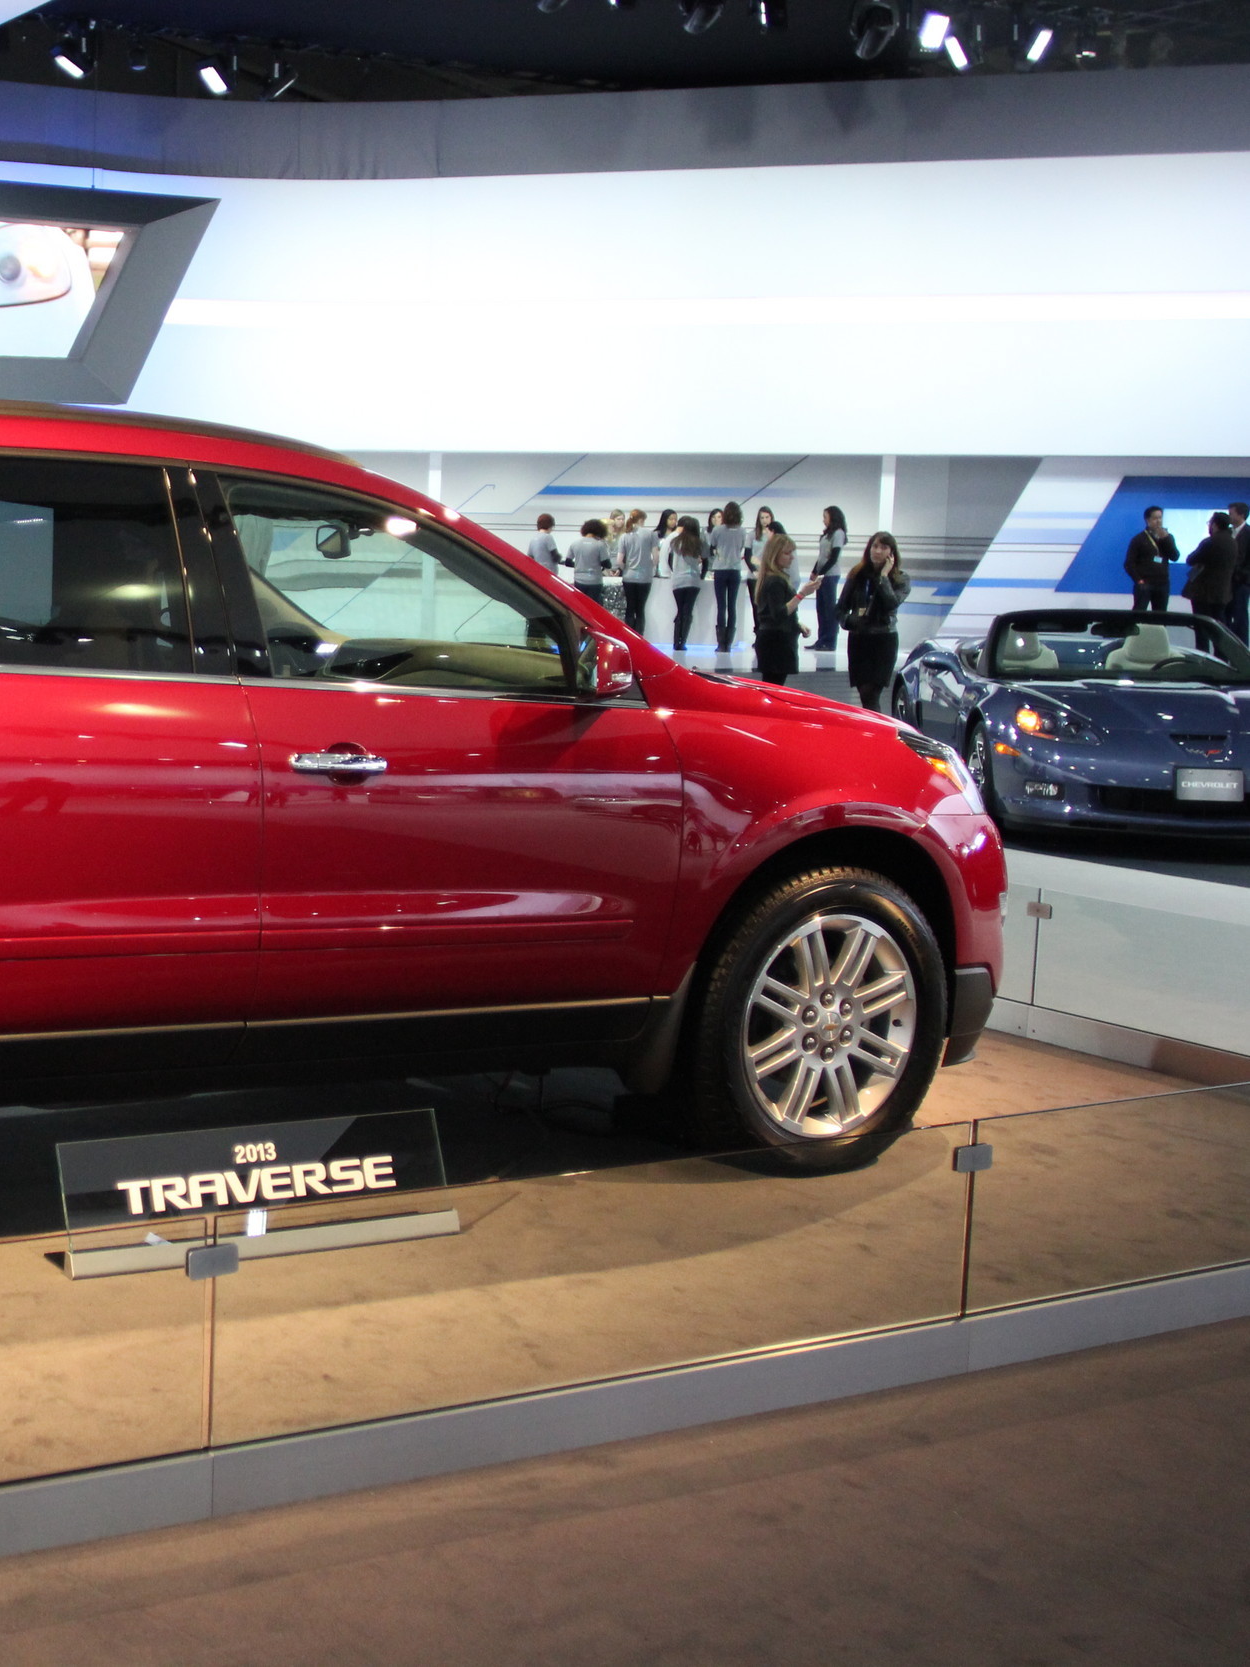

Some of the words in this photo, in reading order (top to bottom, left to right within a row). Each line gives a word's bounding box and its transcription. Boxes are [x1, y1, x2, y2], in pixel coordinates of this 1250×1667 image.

[1180, 780, 1239, 789] CHEVROLET
[234, 1142, 277, 1164] 2013
[117, 1155, 397, 1215] TRAVERSE
